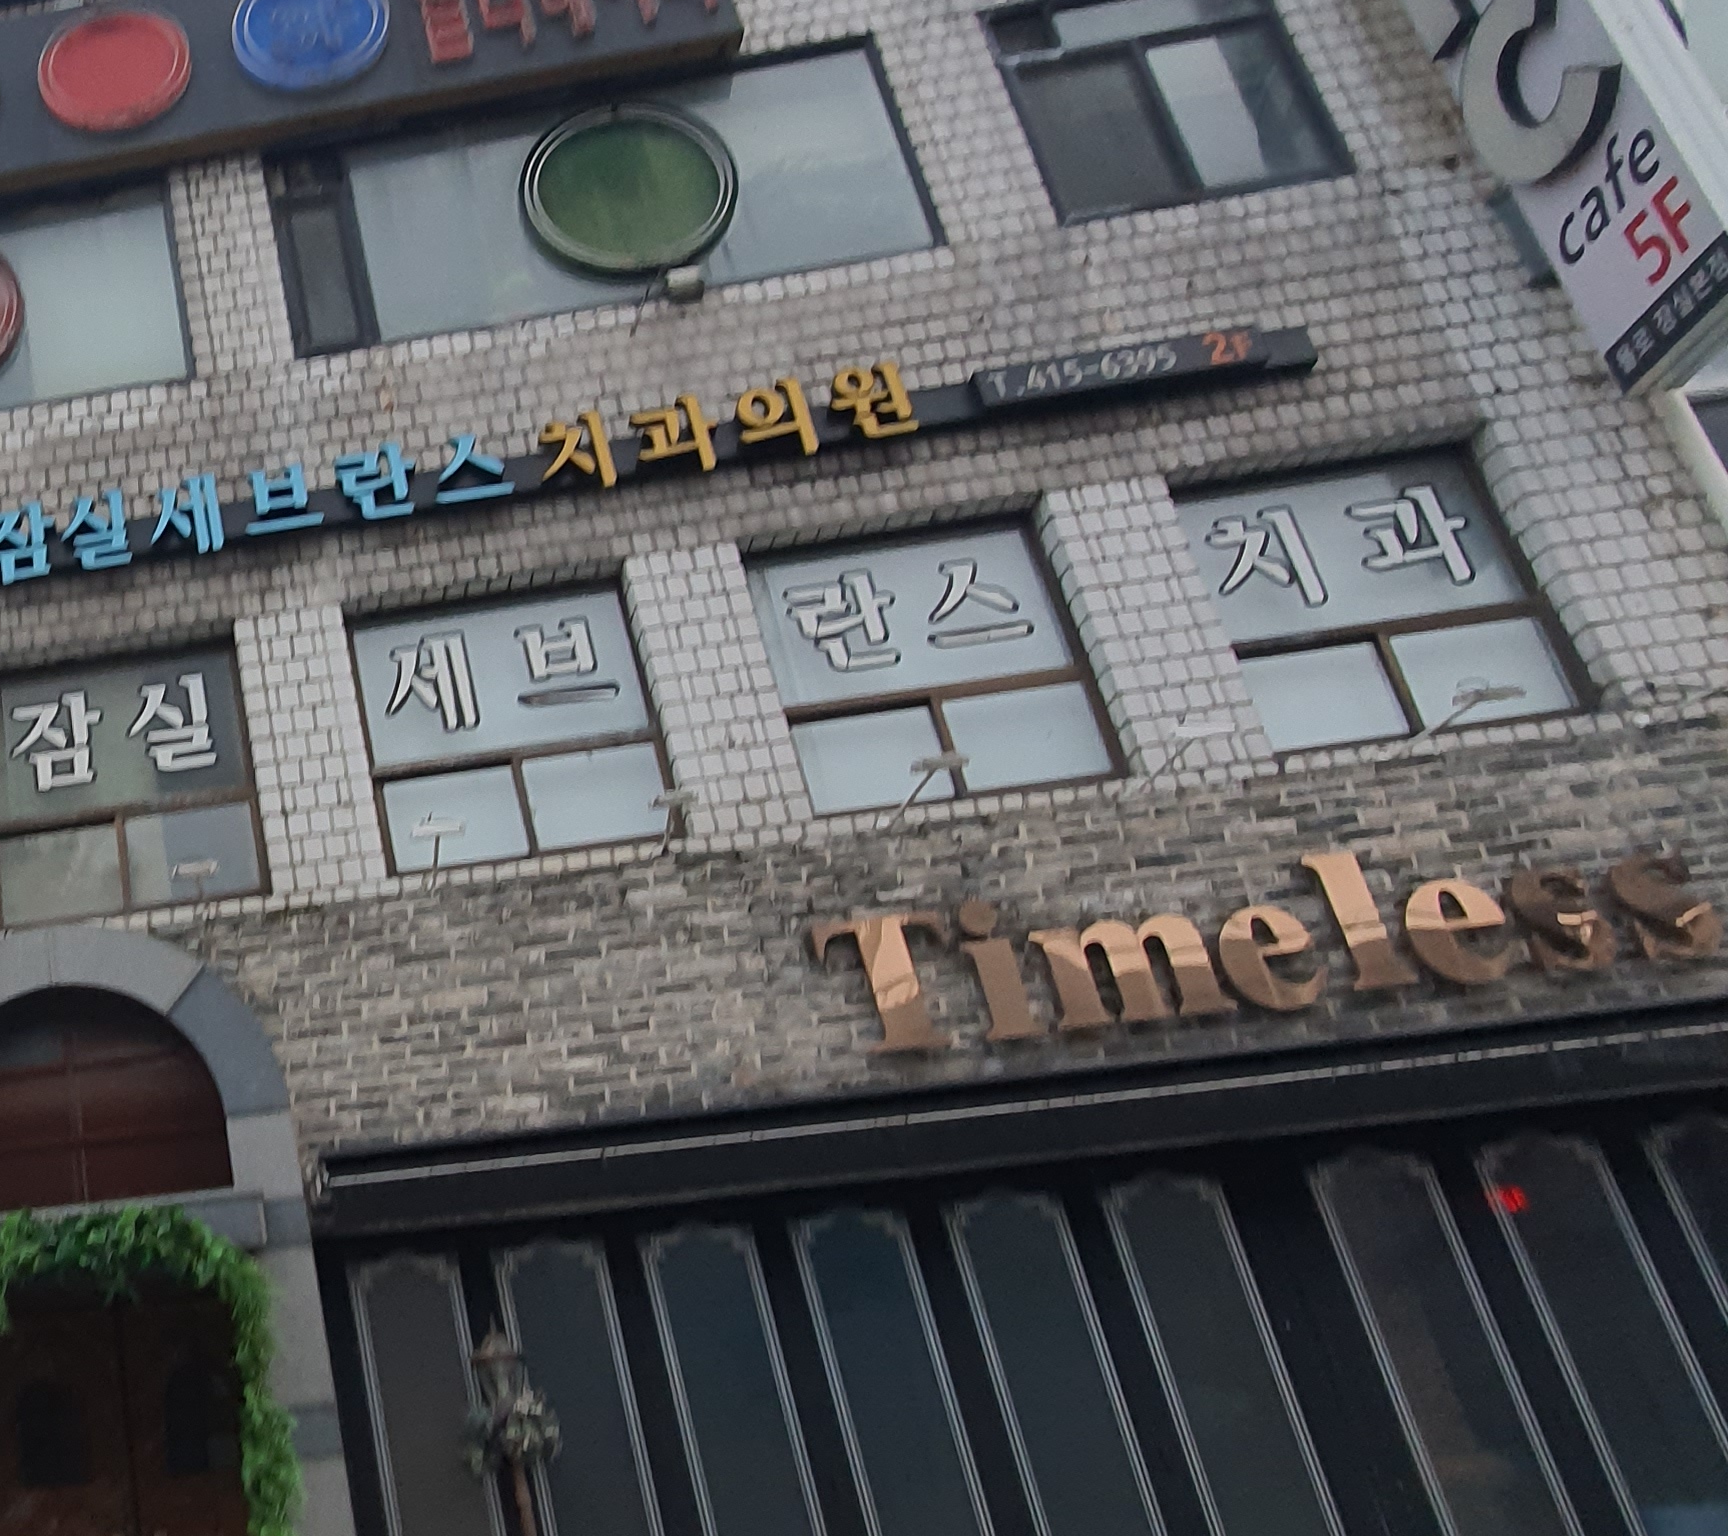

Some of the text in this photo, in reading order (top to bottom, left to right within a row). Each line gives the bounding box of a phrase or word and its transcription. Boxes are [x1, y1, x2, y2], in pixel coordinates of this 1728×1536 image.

[1559, 128, 1661, 265] cafe
[1622, 175, 1692, 287] 5F
[538, 360, 920, 487] 치과의원
[10, 671, 219, 793] 잠실
[1205, 484, 1476, 608] 치과
[812, 853, 1725, 1052] Timeless
